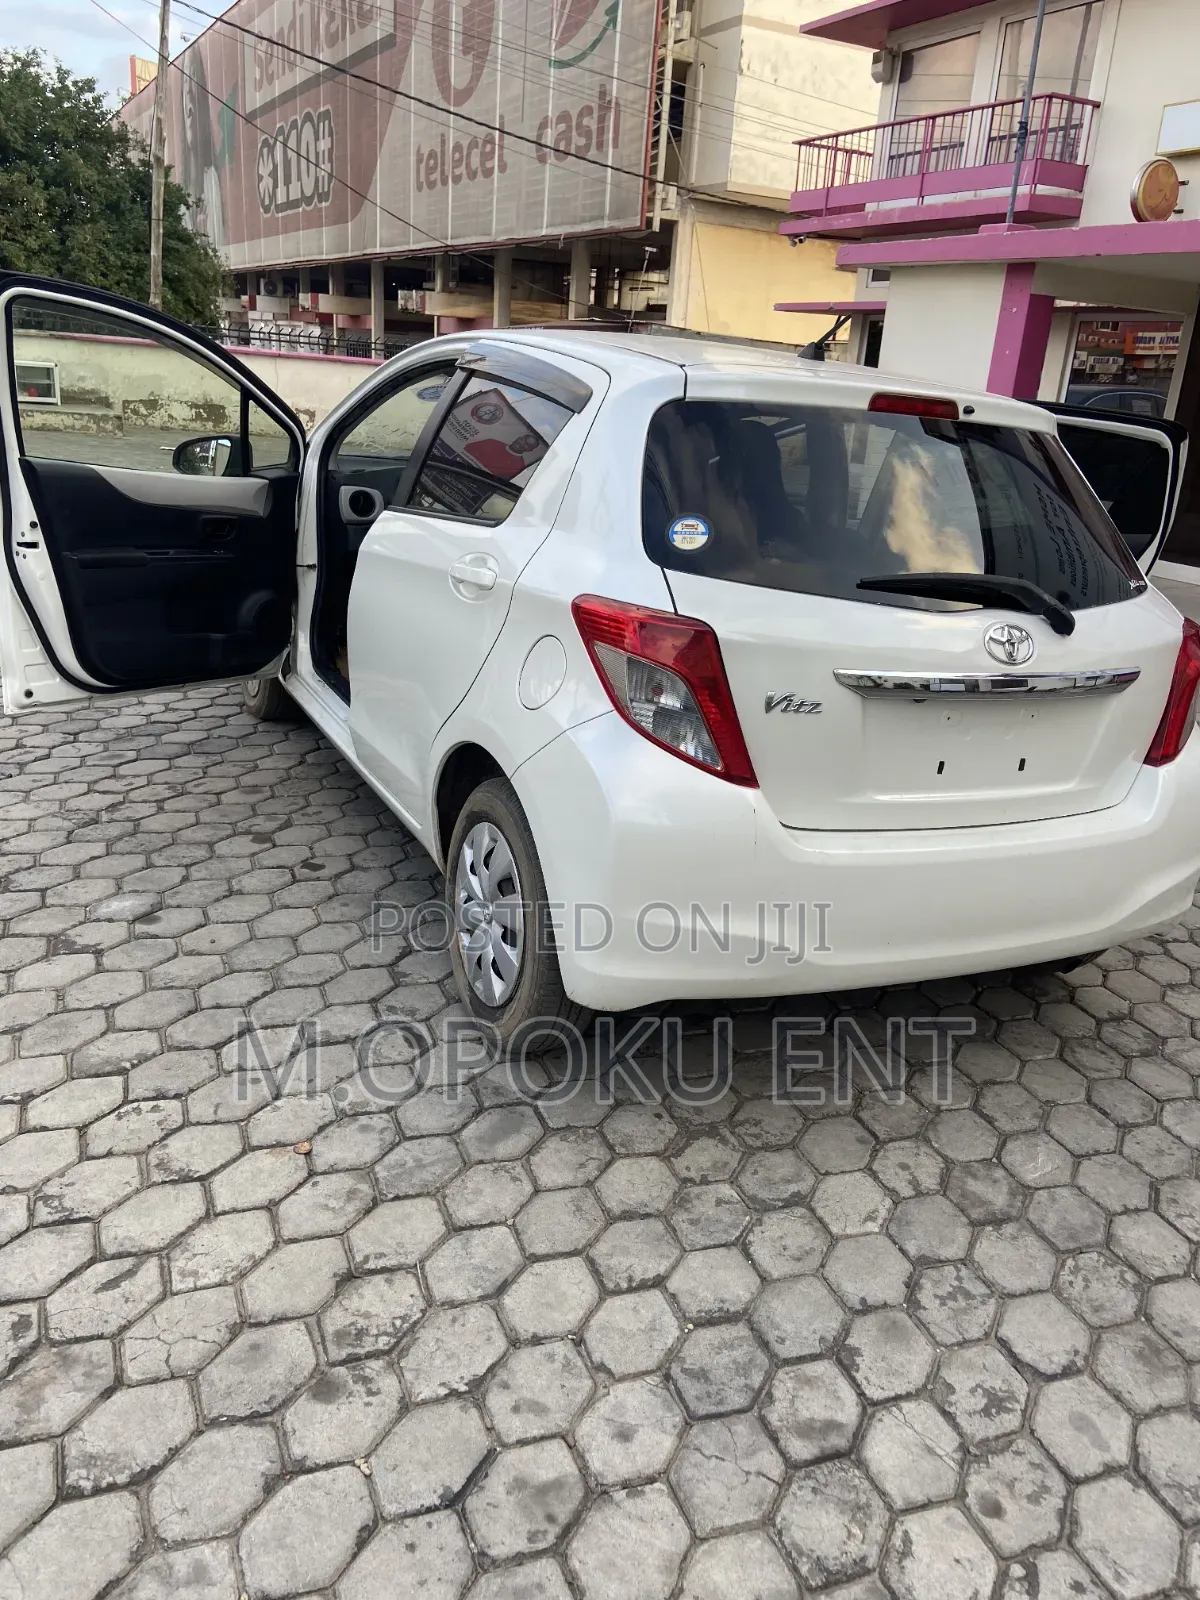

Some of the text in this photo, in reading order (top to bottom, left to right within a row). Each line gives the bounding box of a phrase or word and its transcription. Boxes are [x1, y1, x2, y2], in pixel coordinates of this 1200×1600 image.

[415, 83, 621, 193] telecel cash
[765, 690, 823, 715] Vitz
